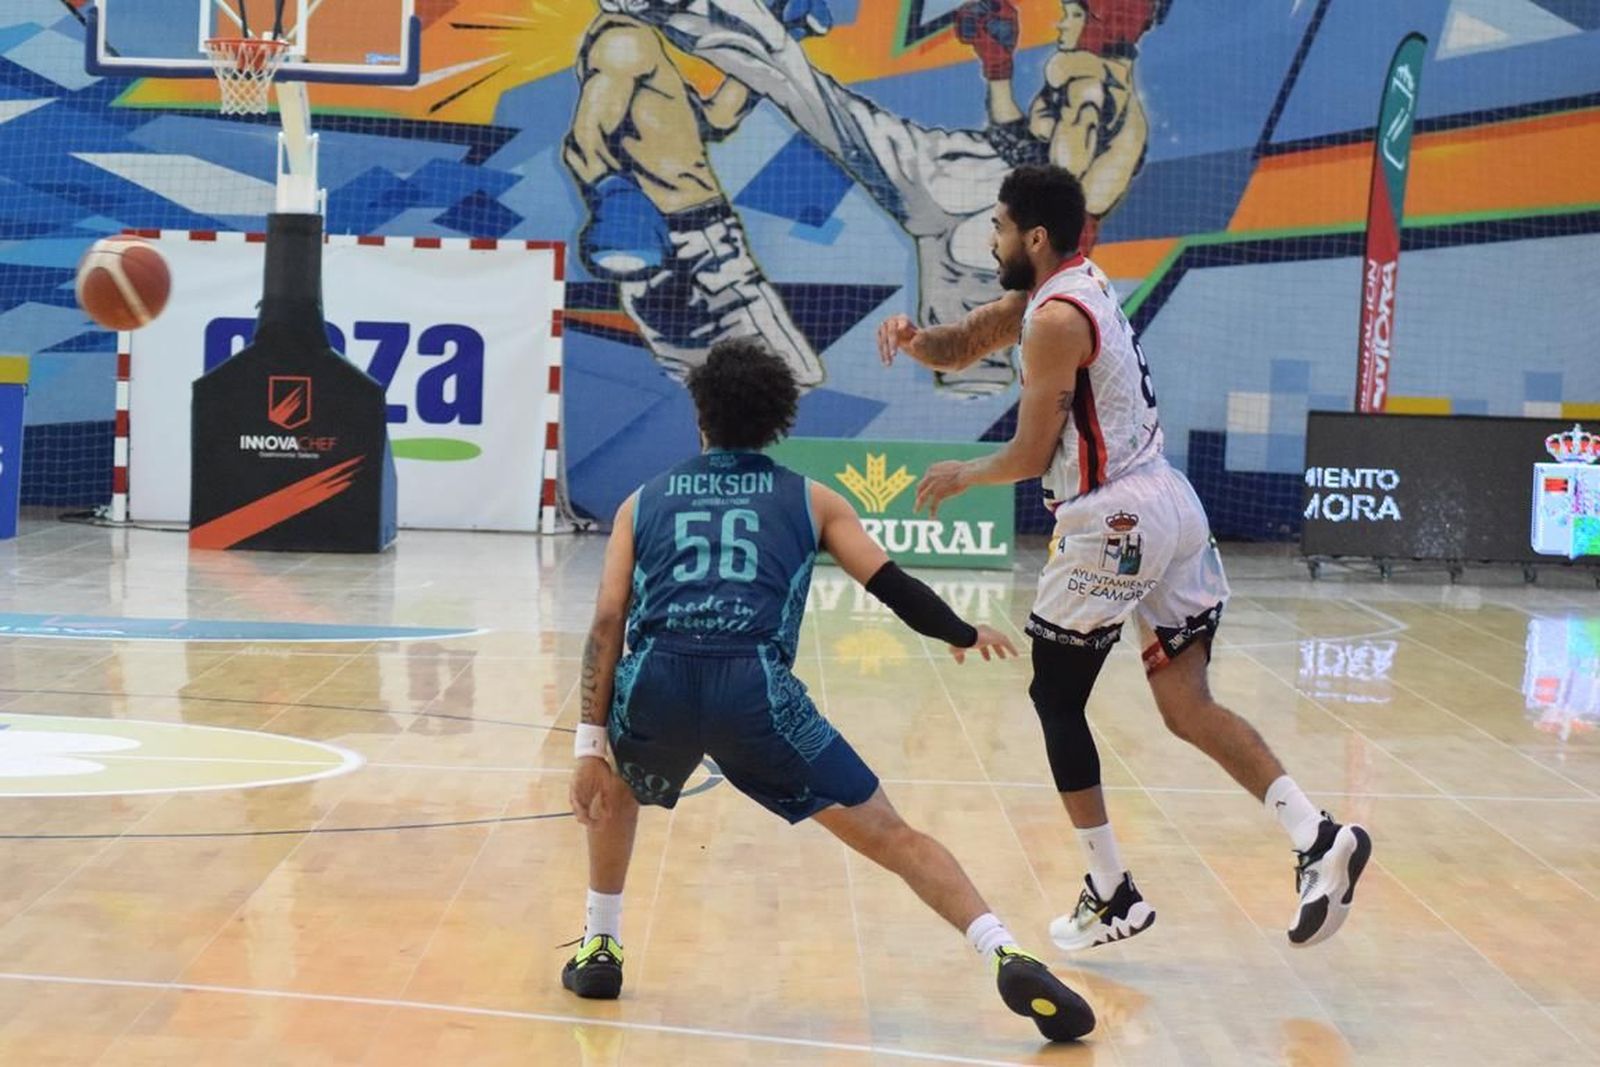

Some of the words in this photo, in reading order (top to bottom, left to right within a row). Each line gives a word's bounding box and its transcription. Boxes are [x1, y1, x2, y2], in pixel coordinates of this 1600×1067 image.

[664, 471, 774, 497] JACKSON
[672, 508, 760, 583] 56
[860, 518, 1007, 556] RURAL
[1067, 578, 1086, 595] DE
[1090, 585, 1144, 601] ZAMOR
[667, 594, 724, 613] made
[733, 597, 758, 617] in
